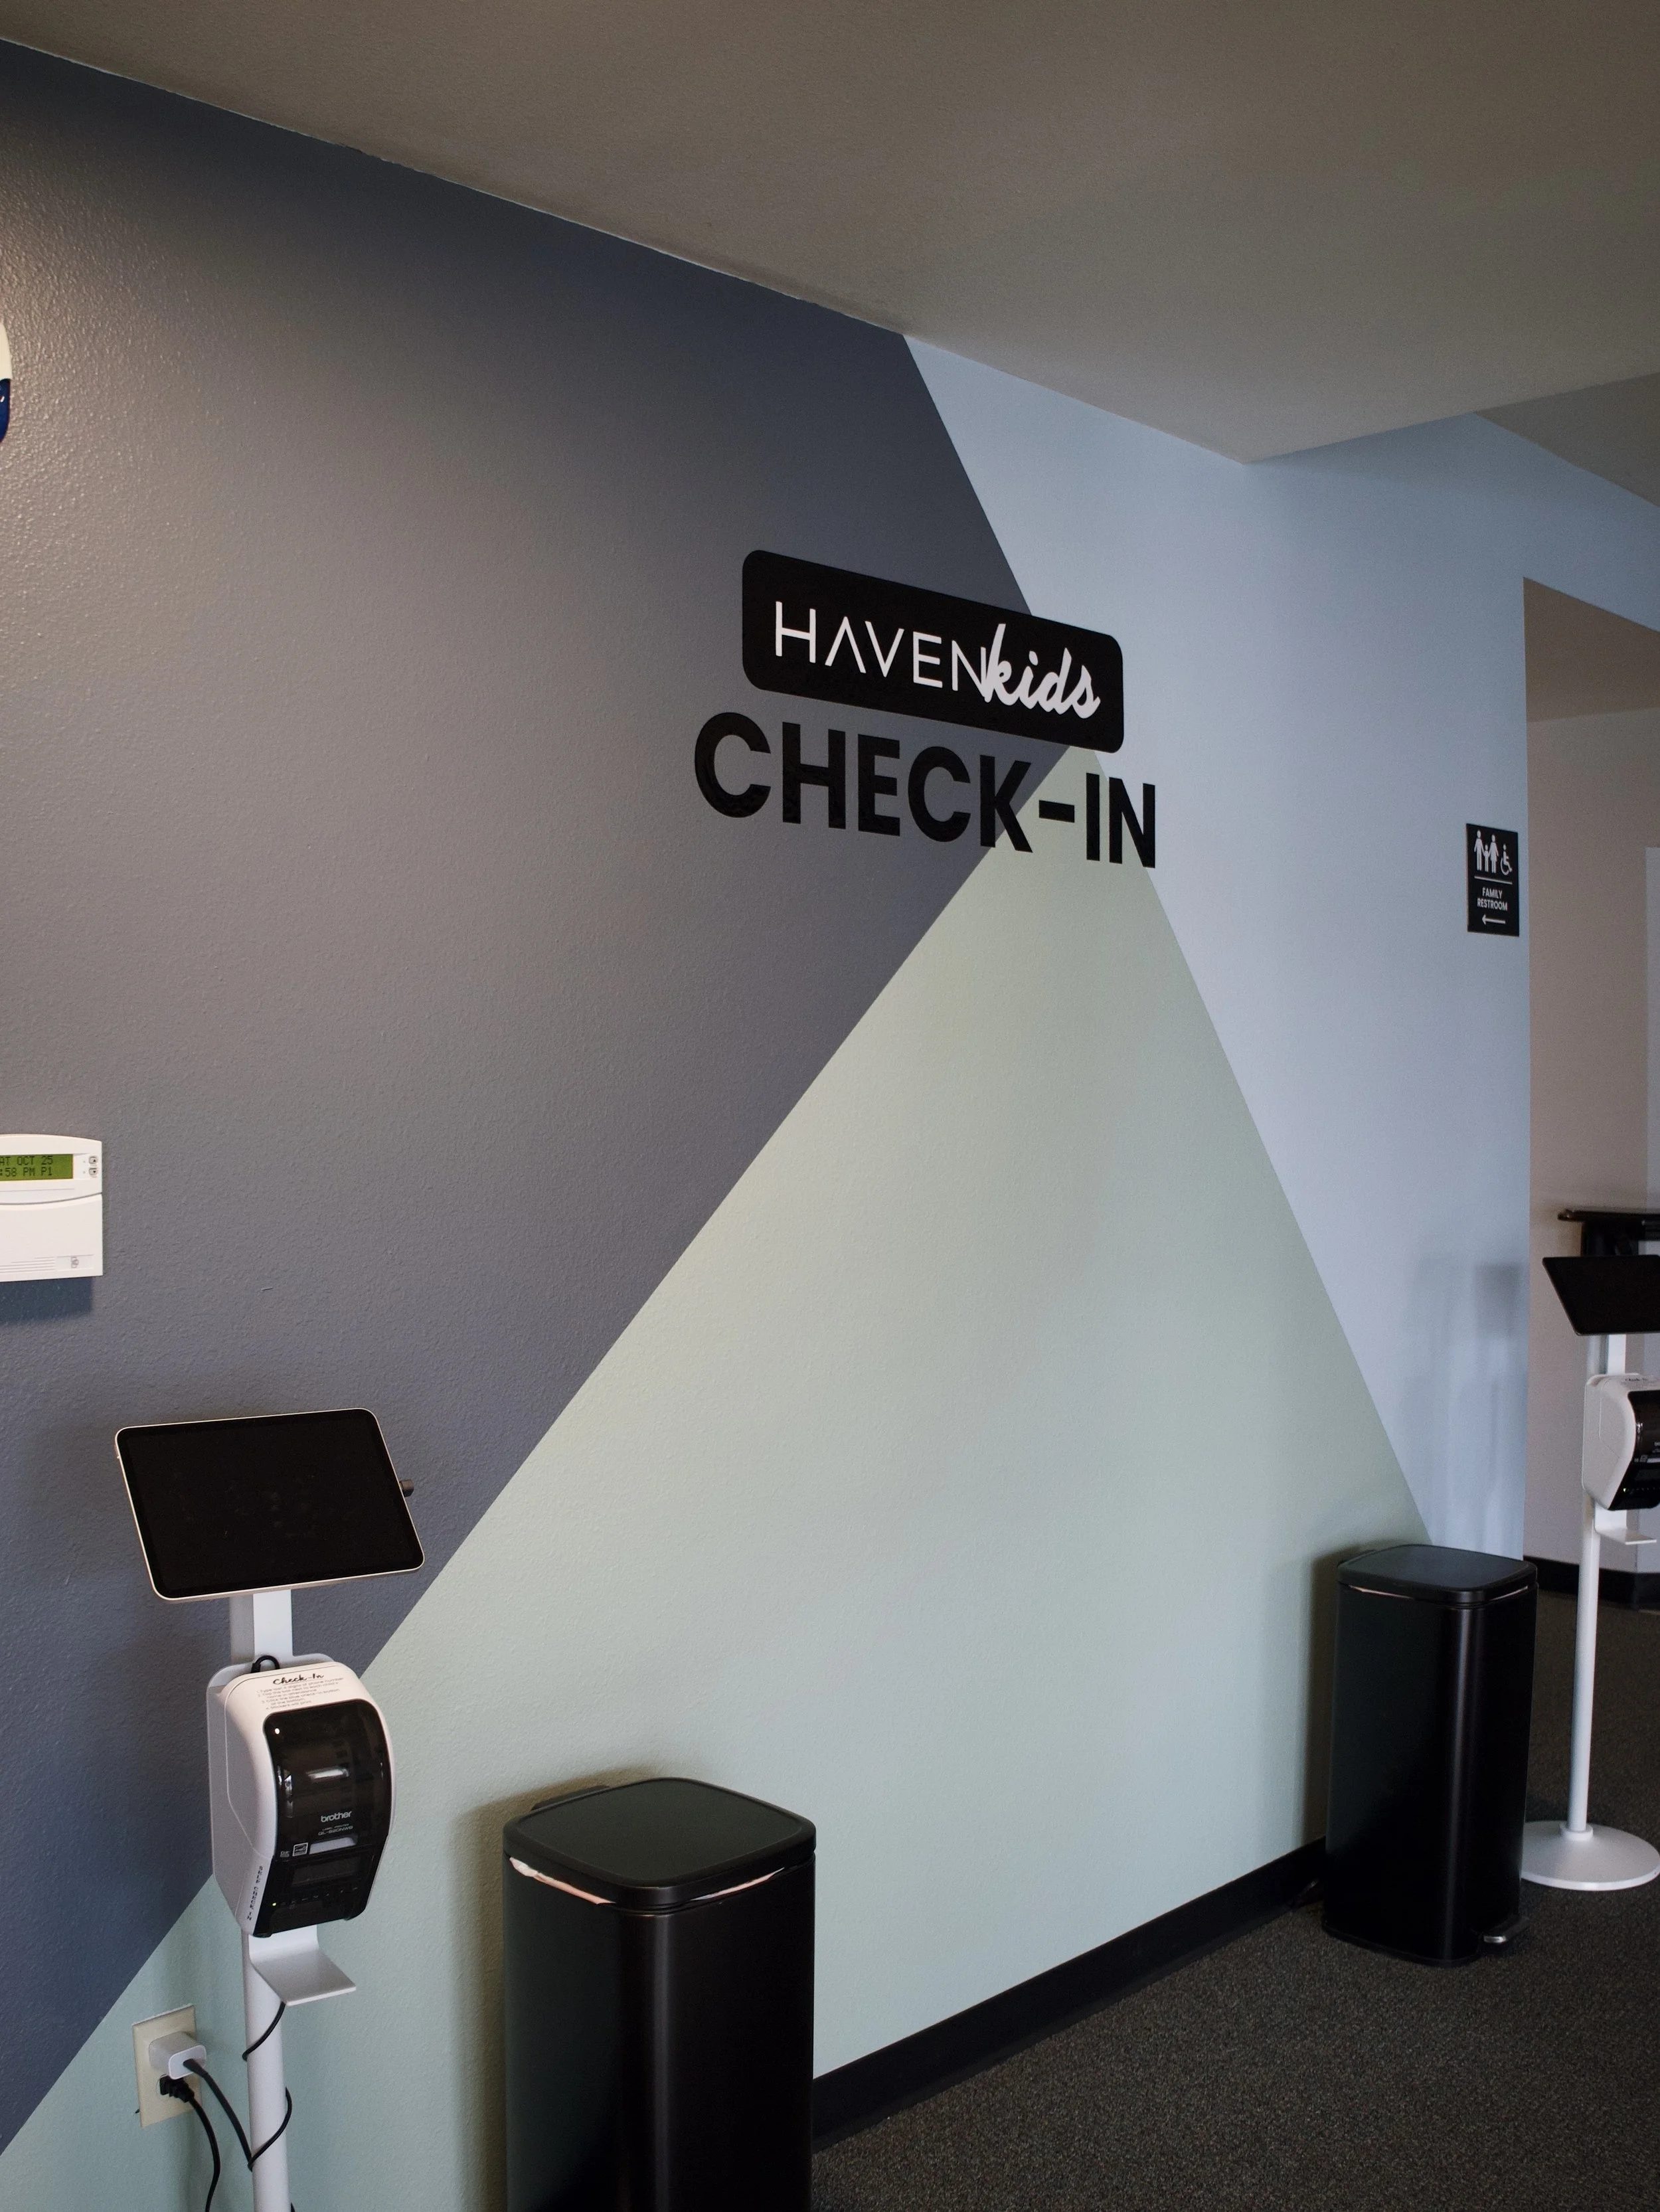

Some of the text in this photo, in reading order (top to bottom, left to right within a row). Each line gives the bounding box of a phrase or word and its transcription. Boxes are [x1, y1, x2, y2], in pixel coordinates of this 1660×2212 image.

[694, 712, 1156, 869] CHECK-IN
[1482, 887, 1503, 899] FAMILY
[1477, 898, 1507, 911] RESTROOM
[17, 1155, 35, 1165] OCT
[41, 1155, 53, 1165] 25
[23, 1167, 35, 1176] PM
[41, 1166, 52, 1176] P1
[273, 1673, 324, 1685] Check-In
[321, 1811, 352, 1822] brother
